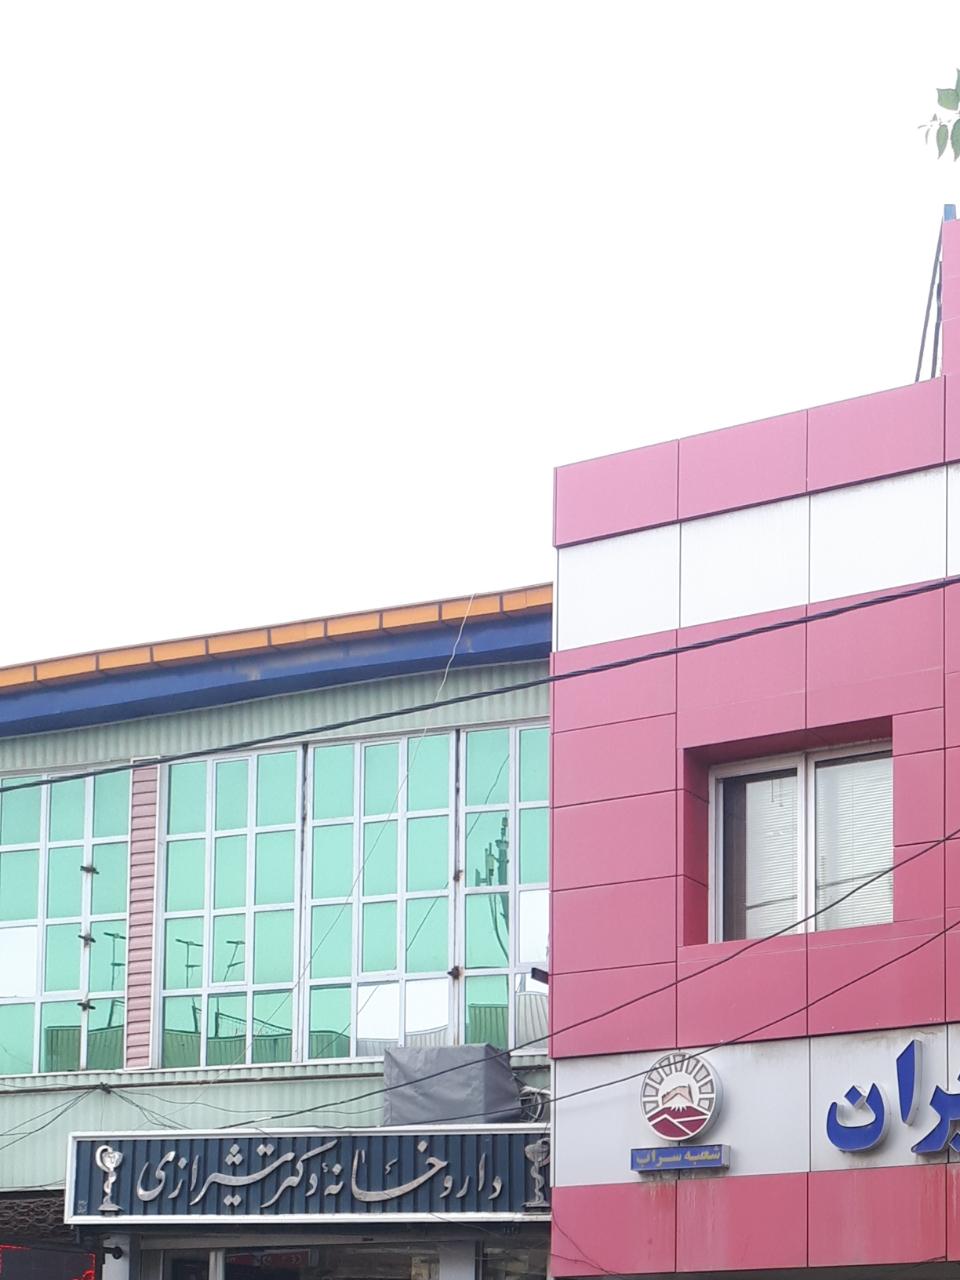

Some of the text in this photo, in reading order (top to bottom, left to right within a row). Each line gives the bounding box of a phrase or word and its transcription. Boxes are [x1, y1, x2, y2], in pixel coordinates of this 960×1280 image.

[136, 1143, 295, 1207] شیرازی
[636, 1146, 721, 1169] شعبه سراب
